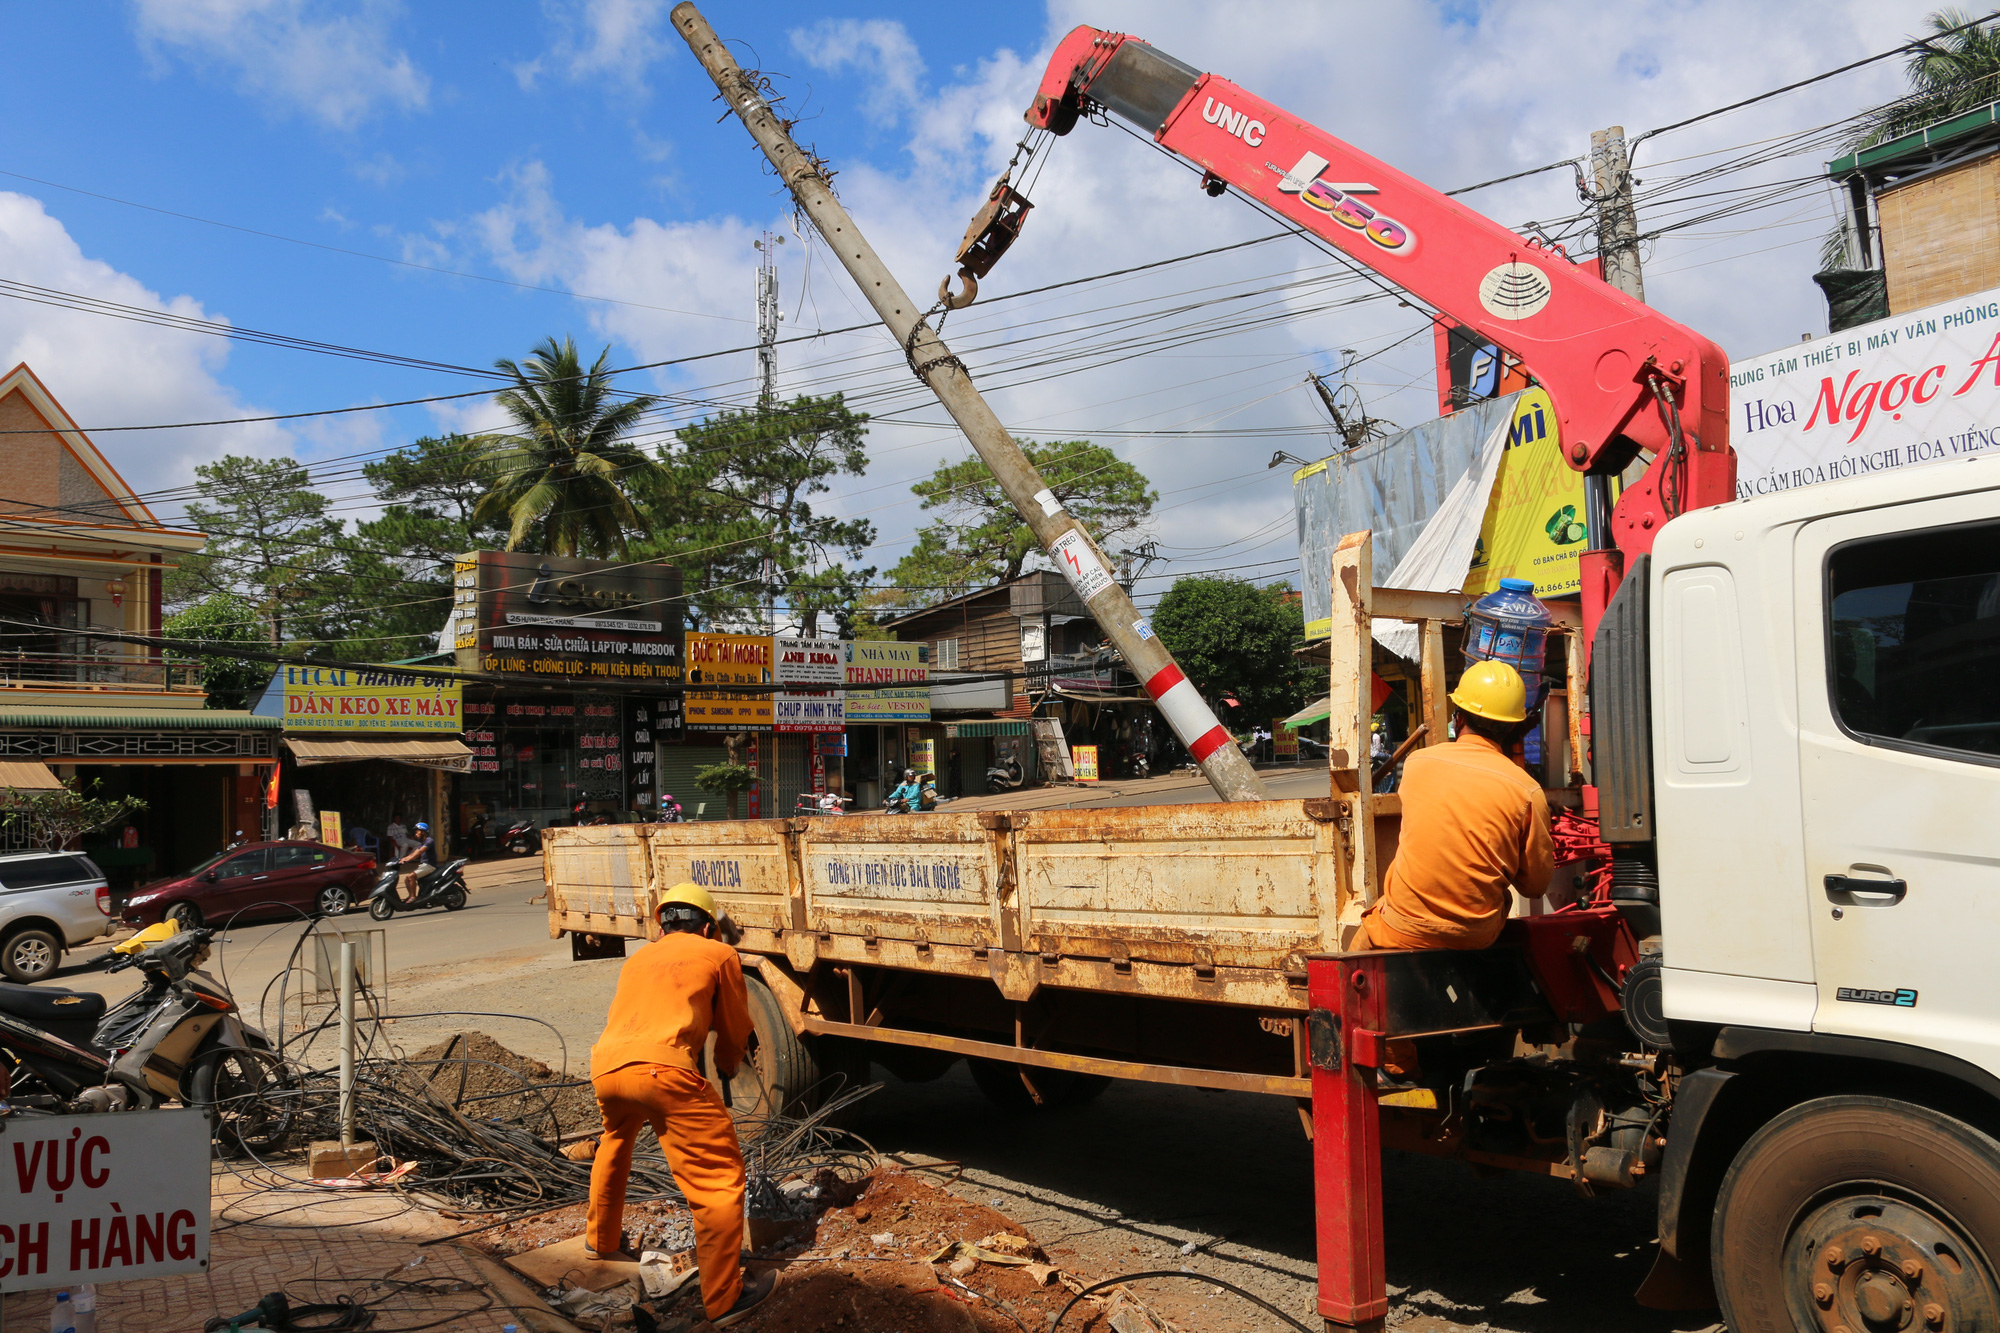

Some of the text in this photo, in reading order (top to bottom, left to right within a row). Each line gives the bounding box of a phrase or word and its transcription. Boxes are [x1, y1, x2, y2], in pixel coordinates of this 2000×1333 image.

[1202, 96, 1266, 147] UNIC
[1730, 302, 2000, 389] RUNG TÂM THIẾT BỊ MÁY VĂN PHÒNG
[1744, 331, 2000, 445] Hoa Ngọc A
[1756, 466, 1790, 494] CẮM
[1792, 463, 1826, 487] HOA
[1906, 439, 1946, 464] HOA
[1533, 579, 1581, 594] 64.866.544
[493, 633, 675, 657] MUA BÁN SỬA CHỮA LAPTOP MACBOOK
[691, 636, 768, 665] ĐỨC TÀI MOBILE
[779, 640, 798, 648] TRUNG
[781, 651, 838, 664] ANH KHOA
[861, 645, 912, 661] NHÀ MAY
[485, 652, 680, 680] ỐP LƯNG CƯỜNG LỰC PHỤ KIỆN ĐIỆN THOẠI
[288, 667, 351, 687] DECAL
[846, 667, 894, 683] THANH
[288, 691, 459, 717] DÁN KEO XE MÁY
[464, 703, 479, 714] MUA
[481, 701, 495, 714] BÁN
[507, 703, 524, 716] ĐIỆN
[525, 705, 546, 717] THOẠI
[551, 706, 576, 716] LAPTOP
[689, 707, 770, 716] IPHONE SAMSUNG OPPO NOKIA
[776, 702, 801, 719] CHỤP
[887, 701, 925, 710] VESTON
[656, 718, 673, 729] LAPTOP
[465, 730, 494, 741] ÉP KÍNH
[580, 733, 594, 748] BÁN
[594, 732, 606, 748] TRẢ
[635, 728, 650, 743] CHỮA
[481, 745, 496, 756] BÁN
[633, 751, 655, 763] LAPTOP
[638, 768, 650, 784] LẤY
[637, 793, 652, 805] NGAY
[691, 860, 742, 888] 48C-027.54
[852, 862, 862, 885] TY
[13, 1127, 111, 1204] VỰC
[0, 1202, 196, 1279] CH HÀNG
